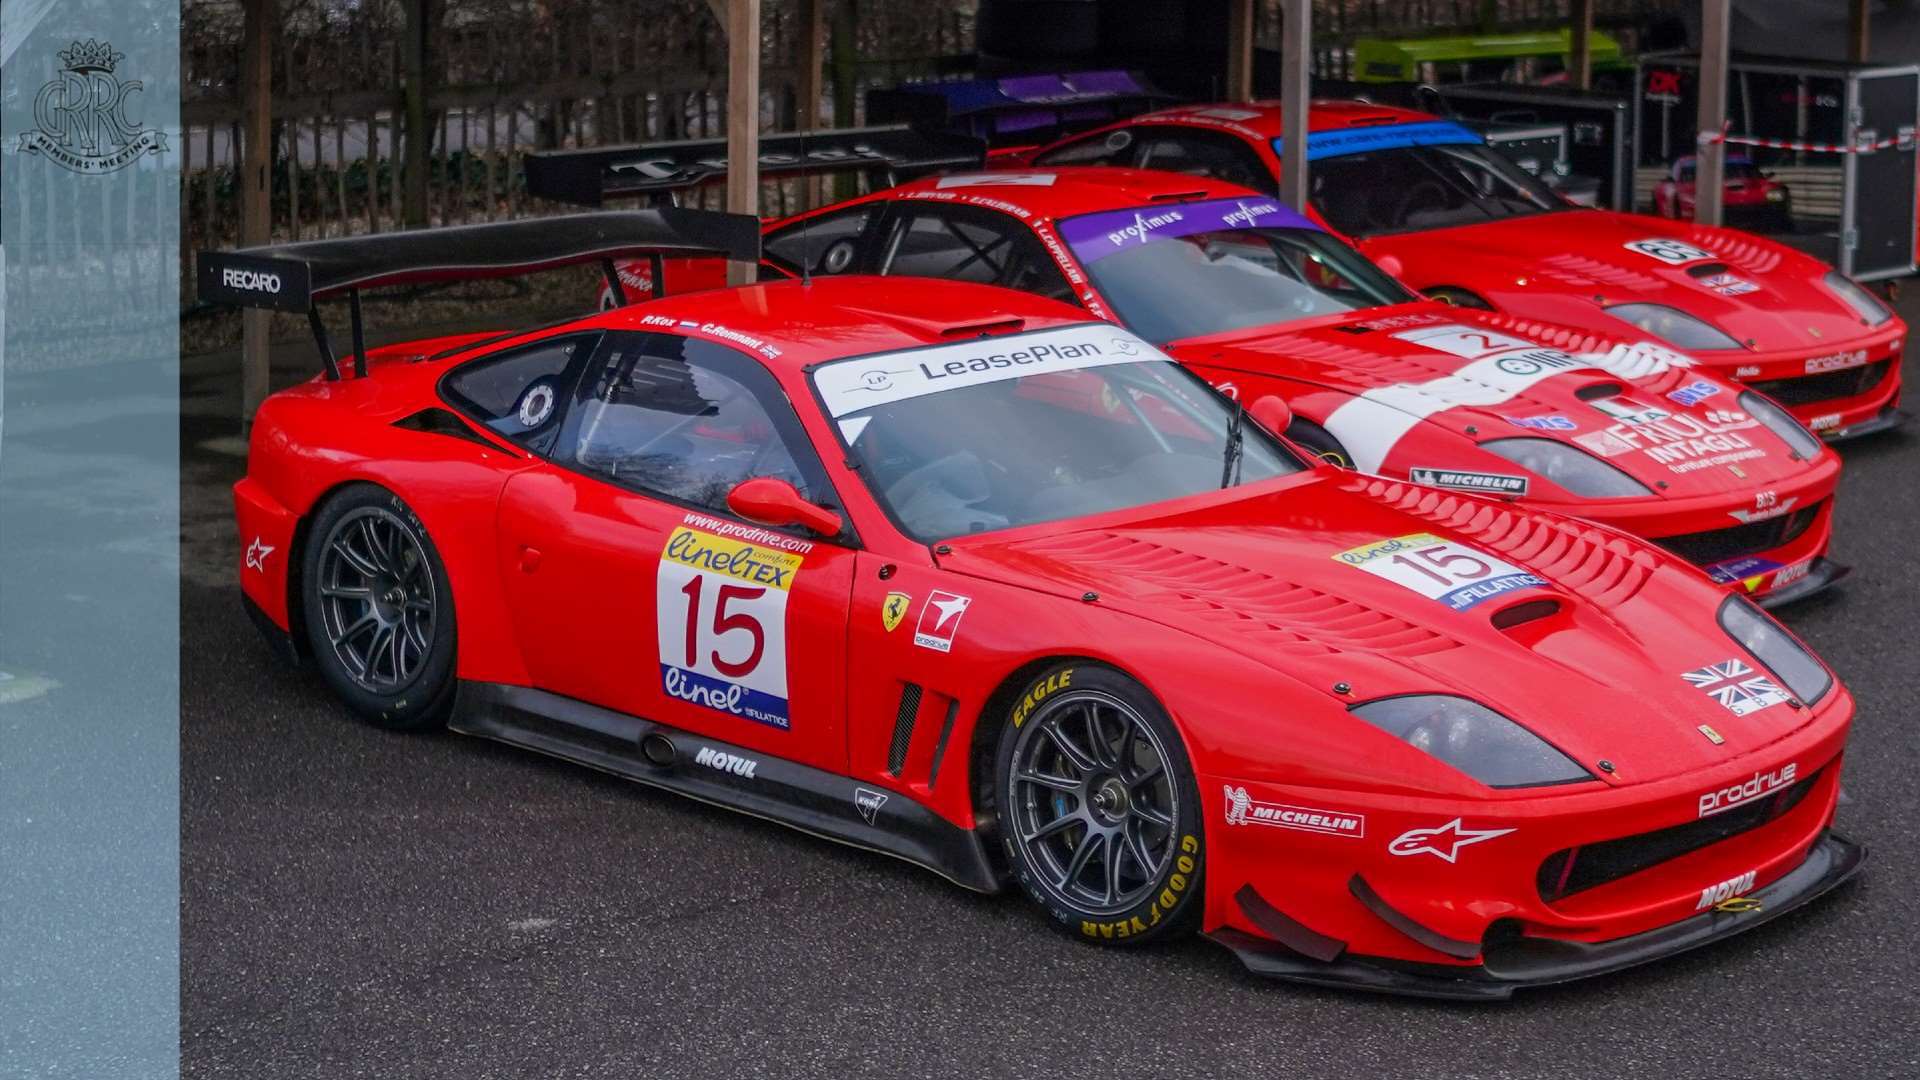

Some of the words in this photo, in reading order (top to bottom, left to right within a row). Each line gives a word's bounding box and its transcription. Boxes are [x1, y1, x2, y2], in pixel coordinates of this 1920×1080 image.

[1109, 213, 1184, 246] proximus
[1222, 202, 1278, 227] proximus
[223, 268, 281, 294] RECARO
[919, 341, 1103, 381] LeasePlan
[1460, 333, 1510, 350] 2
[1439, 474, 1522, 489] MICHELIN
[683, 512, 813, 554] www.prodrive.com
[1392, 545, 1492, 587] 15
[1464, 575, 1544, 602] FILLATTICE
[681, 574, 765, 678] 15
[665, 667, 742, 714] linel
[1013, 669, 1073, 729] EAGLE
[695, 747, 757, 779] MOTUL
[1698, 762, 1797, 818] prodrive
[1253, 807, 1358, 830] MICHELIN
[1696, 870, 1757, 910] MOTUL
